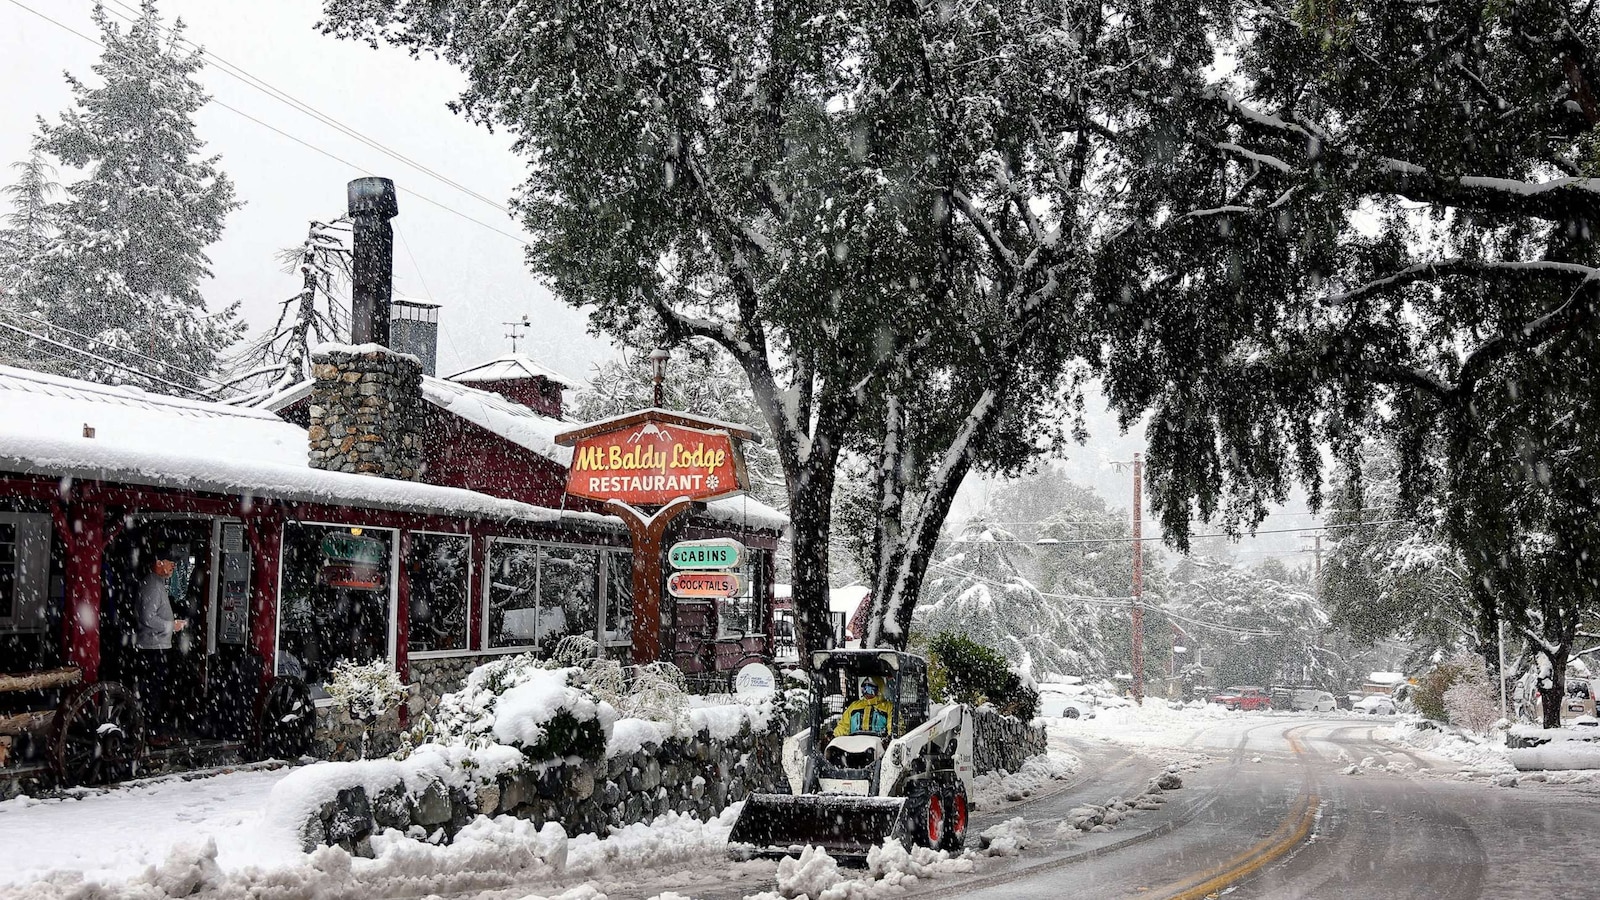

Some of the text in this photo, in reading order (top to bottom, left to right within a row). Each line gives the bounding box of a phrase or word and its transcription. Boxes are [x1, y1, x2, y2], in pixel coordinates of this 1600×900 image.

[669, 443, 726, 474] Lodge
[589, 474, 703, 492] RESTAURANT
[681, 550, 727, 562] CABINS
[679, 580, 729, 591] COCKTAILS
